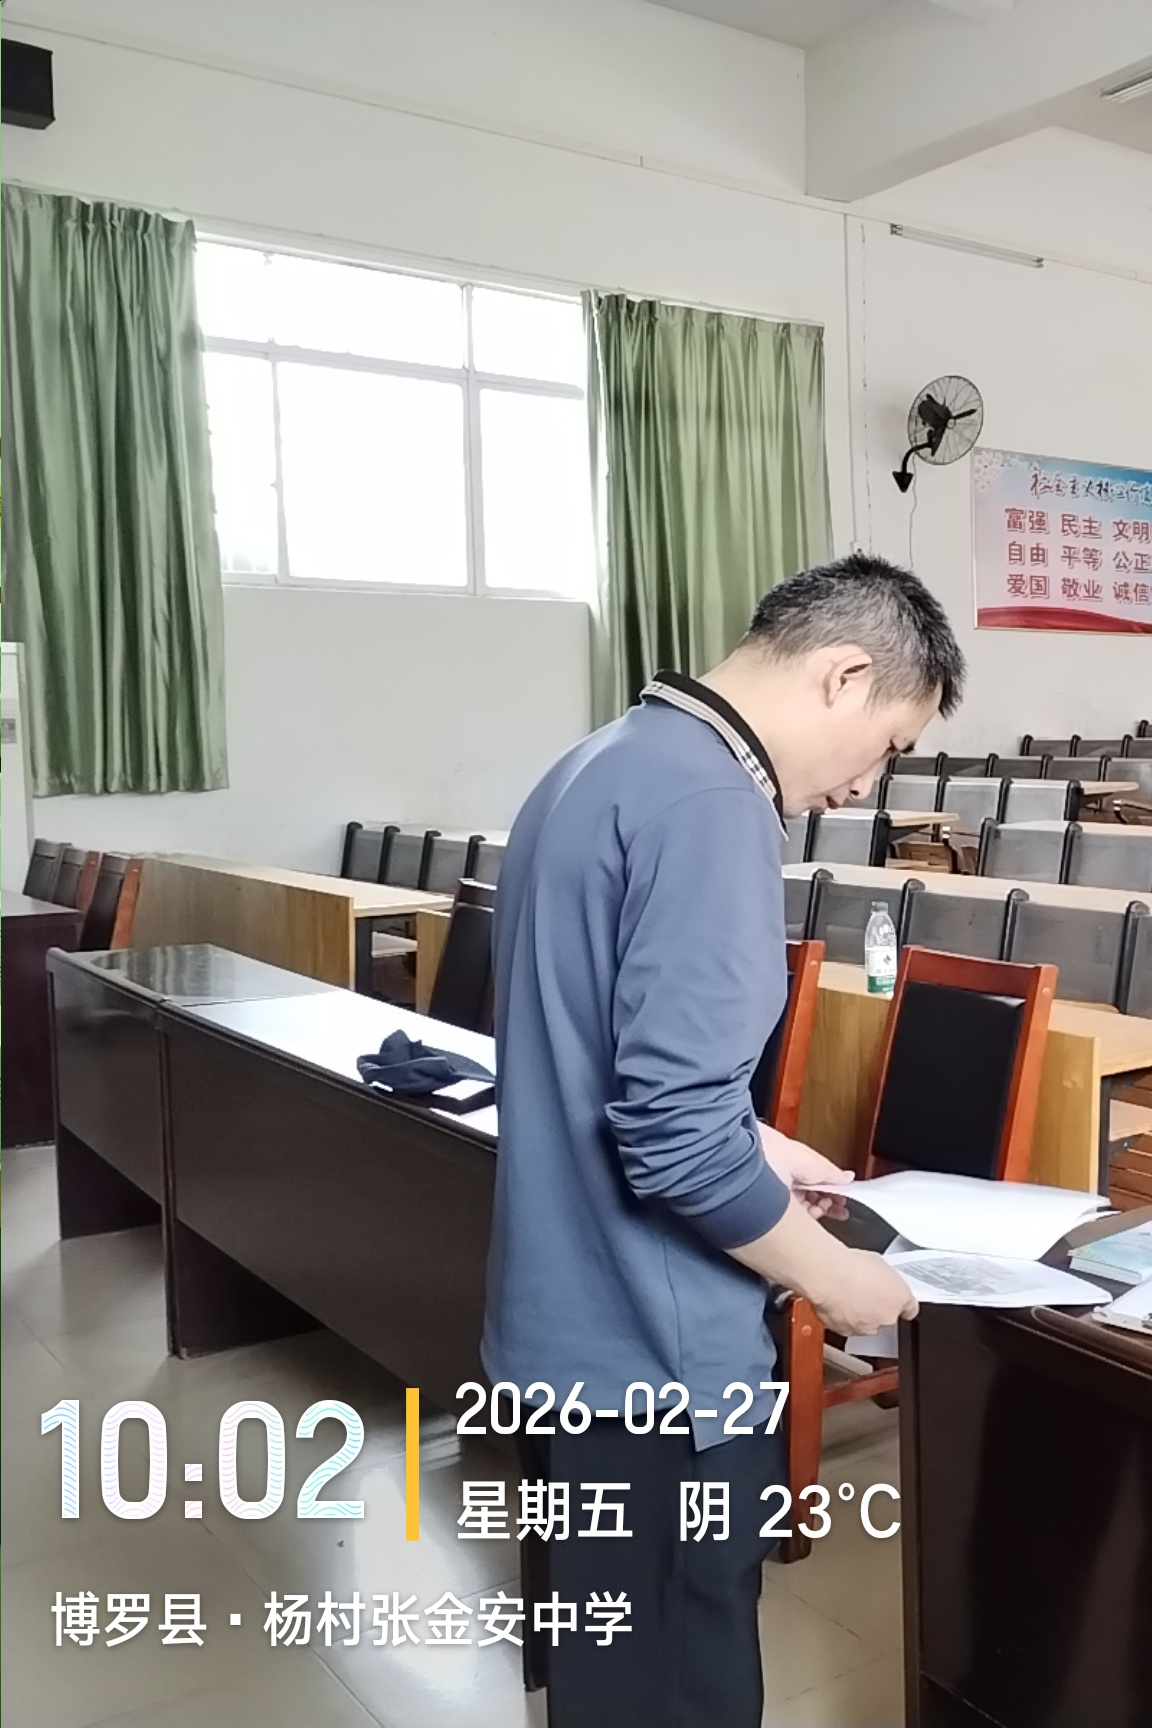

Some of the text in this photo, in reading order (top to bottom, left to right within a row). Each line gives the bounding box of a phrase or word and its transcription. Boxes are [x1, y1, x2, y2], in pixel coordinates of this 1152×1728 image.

[1005, 508, 1049, 533] 富强
[1060, 514, 1102, 539] 民主
[1112, 519, 1152, 543] 文明
[1007, 541, 1049, 566] 自由
[1060, 546, 1102, 570] 平等
[1112, 550, 1152, 574] 公正
[1006, 574, 1049, 598] 爱国
[1060, 577, 1102, 602] 敬业
[1112, 581, 1152, 605] 诚信
